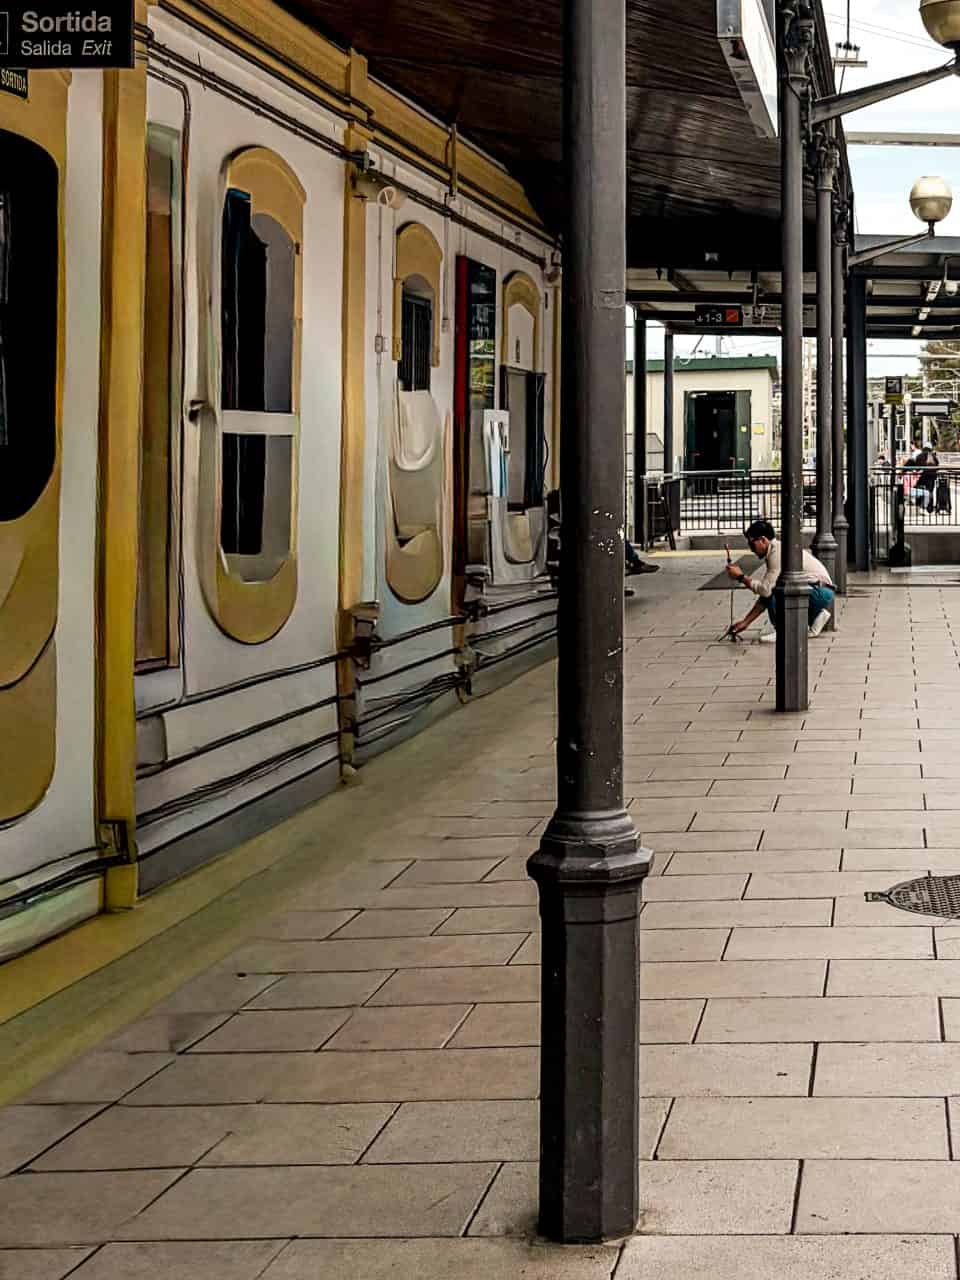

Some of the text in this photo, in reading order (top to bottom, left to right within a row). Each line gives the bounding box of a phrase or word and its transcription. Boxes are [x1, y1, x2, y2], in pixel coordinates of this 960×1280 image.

[21, 10, 112, 32] Sortida
[20, 39, 113, 56] Salida Exit
[0, 68, 27, 94] SORTIDA
